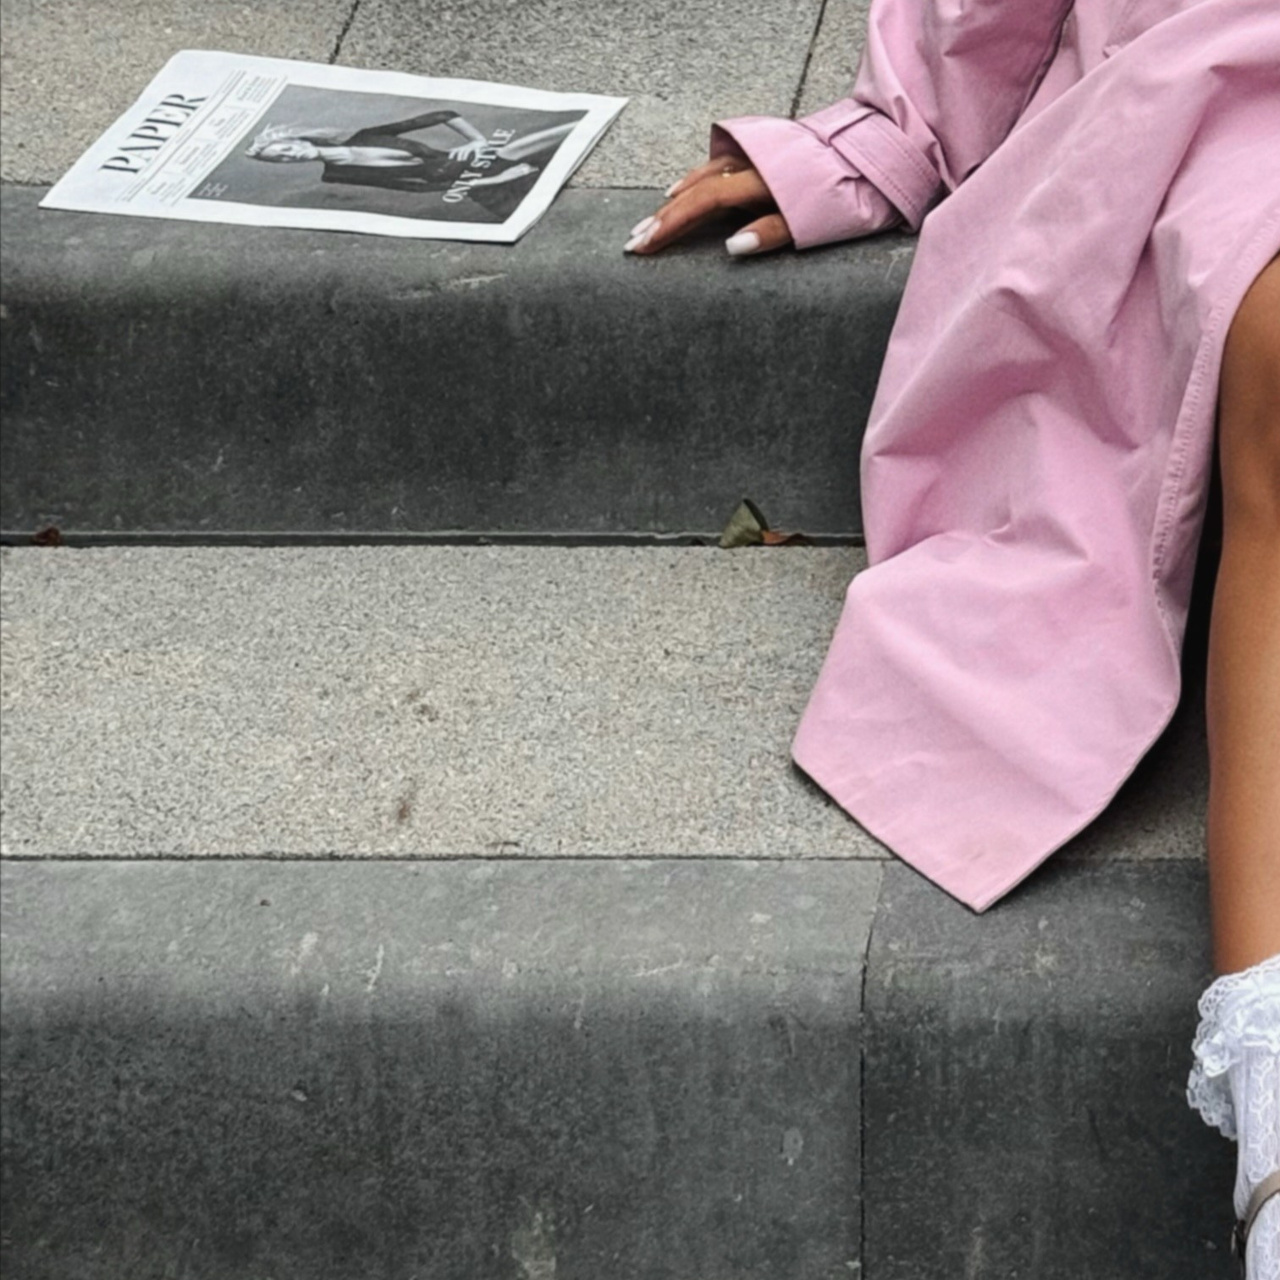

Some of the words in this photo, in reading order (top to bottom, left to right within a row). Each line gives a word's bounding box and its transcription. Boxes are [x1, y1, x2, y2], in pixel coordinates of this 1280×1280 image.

[99, 94, 208, 174] PAPER
[442, 169, 483, 203] ONLY
[470, 128, 516, 169] STYLE
